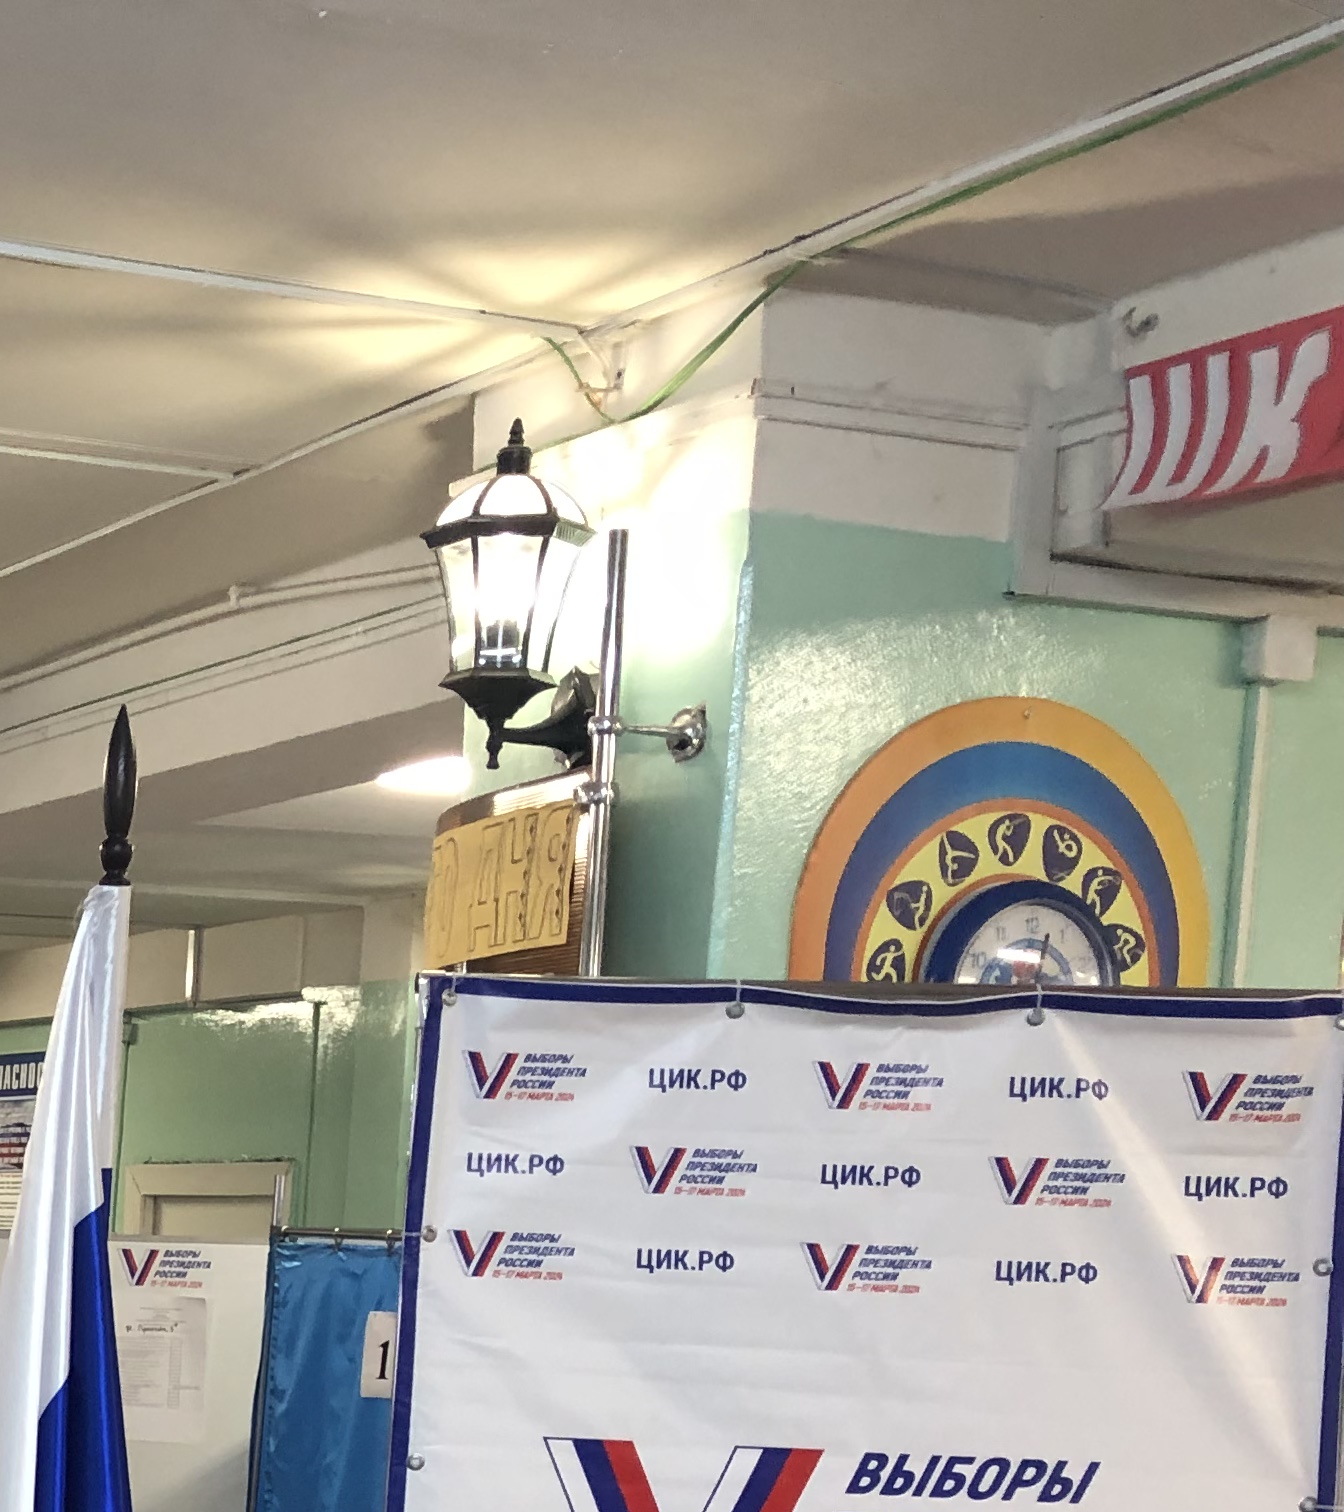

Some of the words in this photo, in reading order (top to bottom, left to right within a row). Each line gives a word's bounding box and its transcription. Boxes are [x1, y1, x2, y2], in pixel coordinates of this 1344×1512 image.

[524, 1054, 574, 1064] ВЫБОРЫ
[517, 1067, 587, 1078] ПРЕЗИДЕНТА
[876, 1064, 928, 1074] ВЫБОРЫ
[510, 1080, 555, 1089] РОССИИ
[649, 1068, 747, 1093] ЦИК.РФ
[870, 1077, 943, 1088] ПРЕЗИДЕНТА
[863, 1090, 910, 1099] РОССИИ
[1009, 1077, 1108, 1102] ЦИК.РФ
[692, 1149, 743, 1159] ВЫБОРЫ
[467, 1152, 564, 1177] ЦИК.РФ
[686, 1162, 757, 1174] ПРЕЗИДЕНТА
[679, 1174, 725, 1184] РОССИИ
[821, 1164, 920, 1190] ЦИК.РФ
[1185, 1176, 1288, 1201] ЦИК.РФ
[510, 1233, 561, 1243] ВЫБОРЫ
[504, 1245, 575, 1257] ПРЕЗИДЕНТА
[865, 1245, 917, 1256] ВЫБОРЫ
[497, 1258, 543, 1268] РОССИИ
[637, 1248, 734, 1273] ЦИК.РФ
[859, 1258, 932, 1270] ПРЕЗИДЕНТА
[852, 1271, 899, 1281] РОССИИ
[996, 1261, 1097, 1286] ЦИК.РФ
[376, 1340, 390, 1380] 1
[845, 1453, 1100, 1504] ВЫБОРЫ
